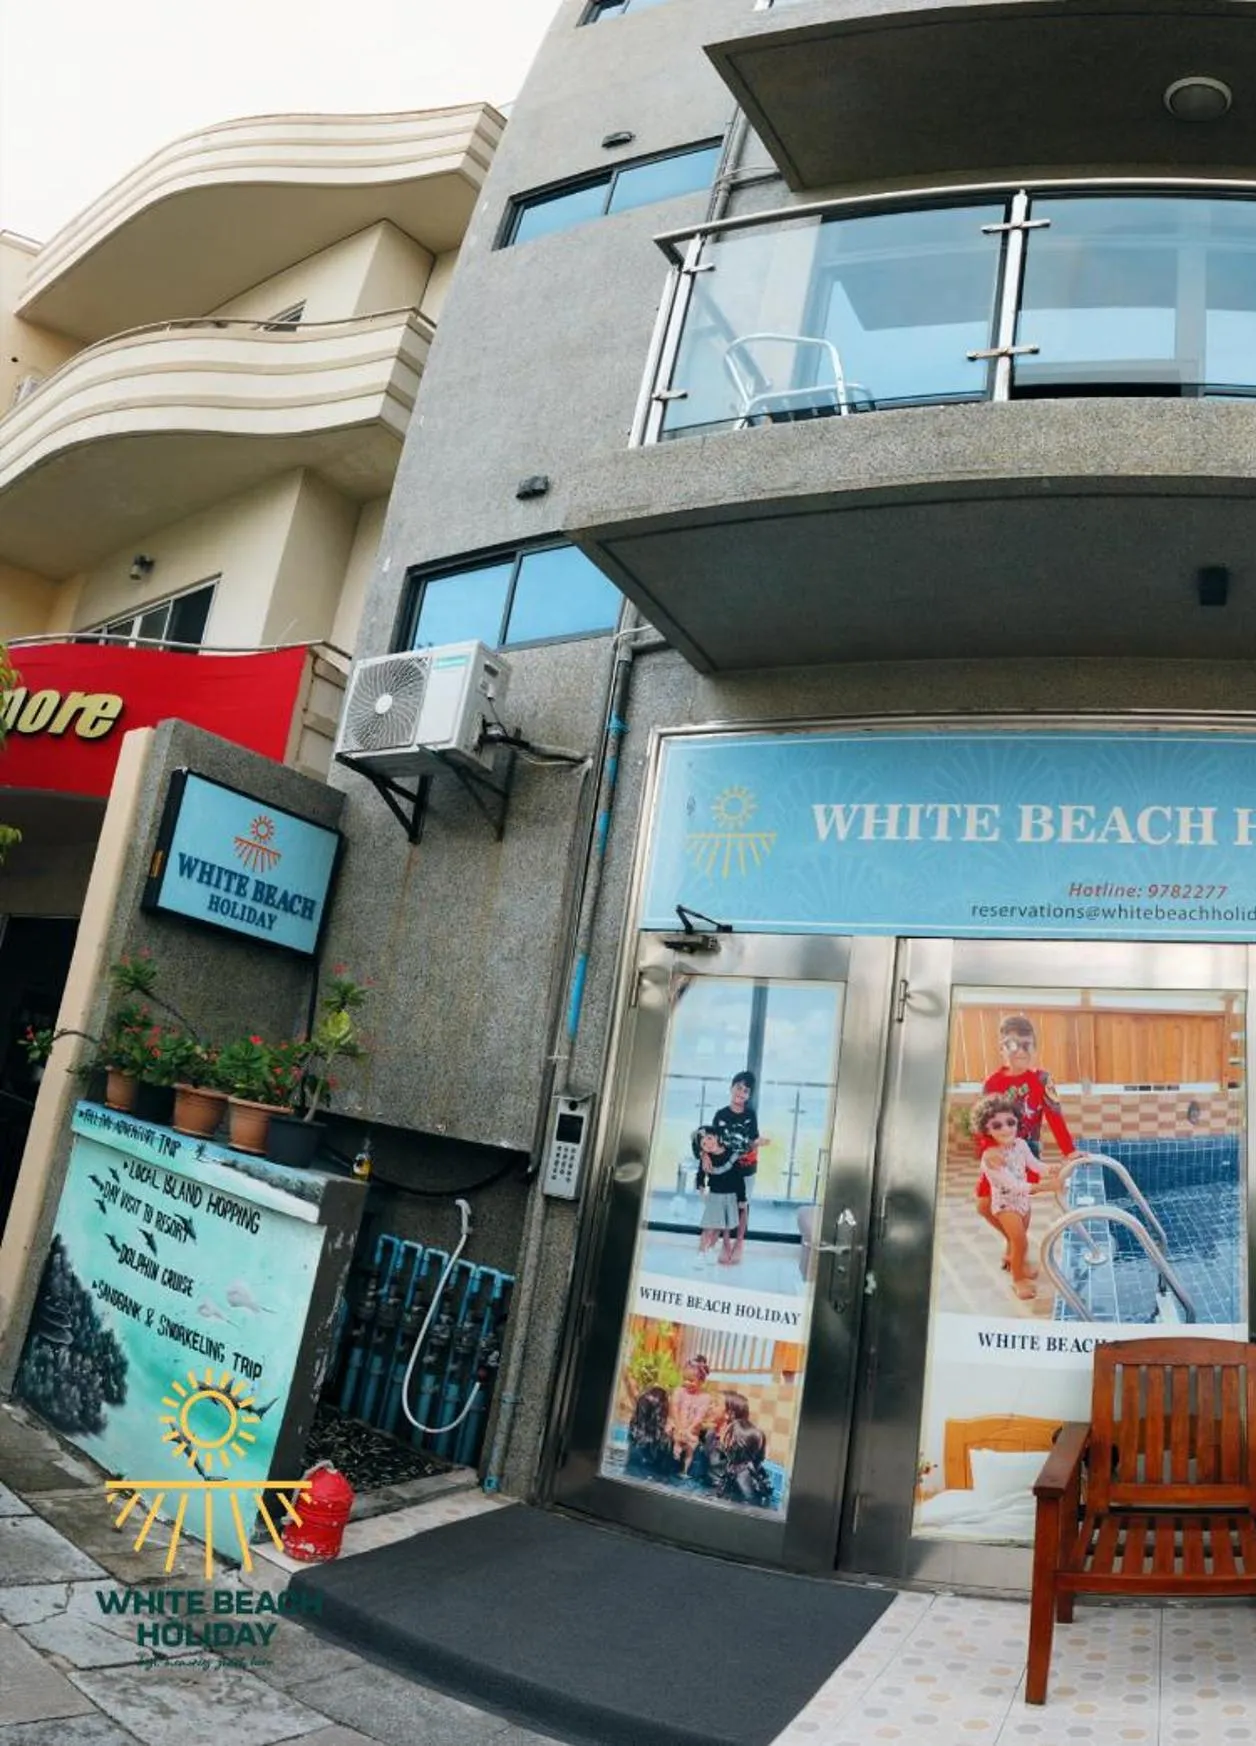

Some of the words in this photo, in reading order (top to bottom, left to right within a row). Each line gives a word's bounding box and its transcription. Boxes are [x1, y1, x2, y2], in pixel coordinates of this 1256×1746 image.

[812, 803, 999, 843] WHITE
[1016, 805, 1218, 846] BEACH
[177, 852, 248, 896] WHITE
[254, 878, 318, 922] BEACH
[1068, 882, 1142, 899] Hotline:
[1148, 883, 1229, 900] 9782277
[207, 894, 278, 931] HOLIDAY
[158, 1134, 181, 1159] TRIP
[103, 1181, 121, 1205] DAY
[120, 1187, 142, 1214] VISIT
[128, 1160, 159, 1190] LOCAL
[162, 1174, 202, 1208] ISLAND
[206, 1192, 261, 1234] HOPPING
[118, 1242, 160, 1283] DOLPHIN
[161, 1266, 195, 1298] CRUISE
[639, 1286, 682, 1305] WHITE
[686, 1294, 731, 1315] BEACH
[735, 1304, 801, 1326] HOLIDAY
[97, 1280, 143, 1323] SANDBANK
[144, 1307, 156, 1328] &
[157, 1315, 226, 1363] SNORKELING
[232, 1351, 263, 1381] TRIP
[978, 1331, 1041, 1351] WHITE
